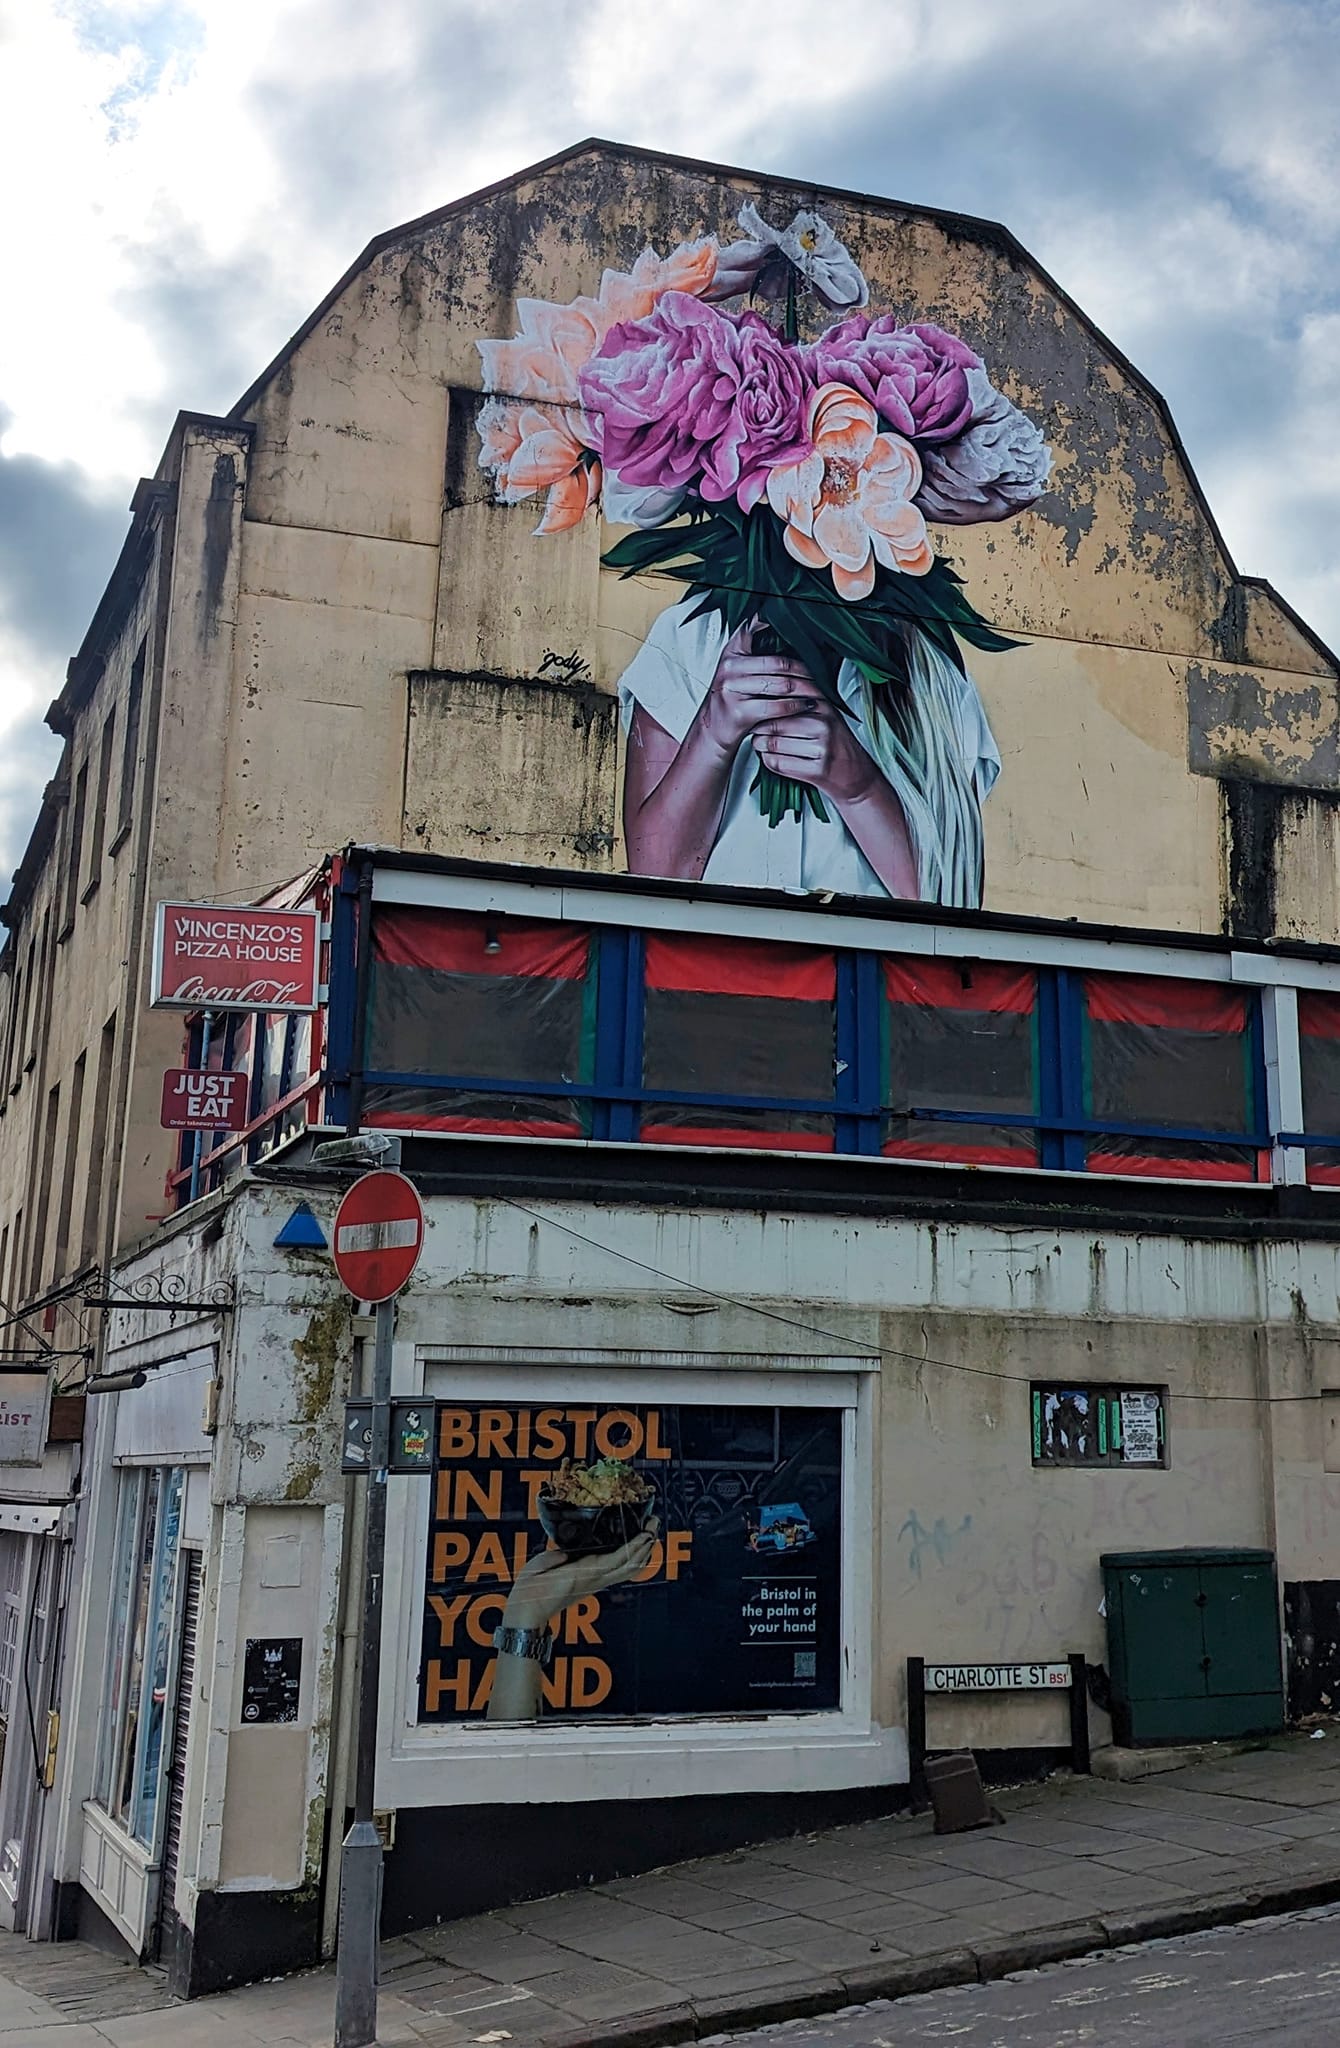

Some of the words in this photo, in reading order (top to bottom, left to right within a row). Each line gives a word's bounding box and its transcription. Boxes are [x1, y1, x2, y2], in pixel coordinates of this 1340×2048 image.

[174, 918, 303, 944] VINCENZO'S
[175, 941, 232, 959] PIZZA
[236, 945, 302, 963] HOUSE
[173, 1074, 236, 1097] JUST
[187, 1097, 234, 1118] EAT
[438, 1408, 672, 1460] BRISTOL
[436, 1470, 503, 1521] IN
[760, 1587, 801, 1600] Bristol
[804, 1587, 817, 1600] in
[742, 1603, 763, 1616] the
[766, 1603, 799, 1619] palm
[803, 1603, 817, 1616] of
[749, 1624, 780, 1636] your
[783, 1619, 816, 1633] hand
[934, 1667, 1022, 1688] CHARLOTTE
[1029, 1666, 1047, 1685] ST
[1049, 1673, 1067, 1684] BS1
